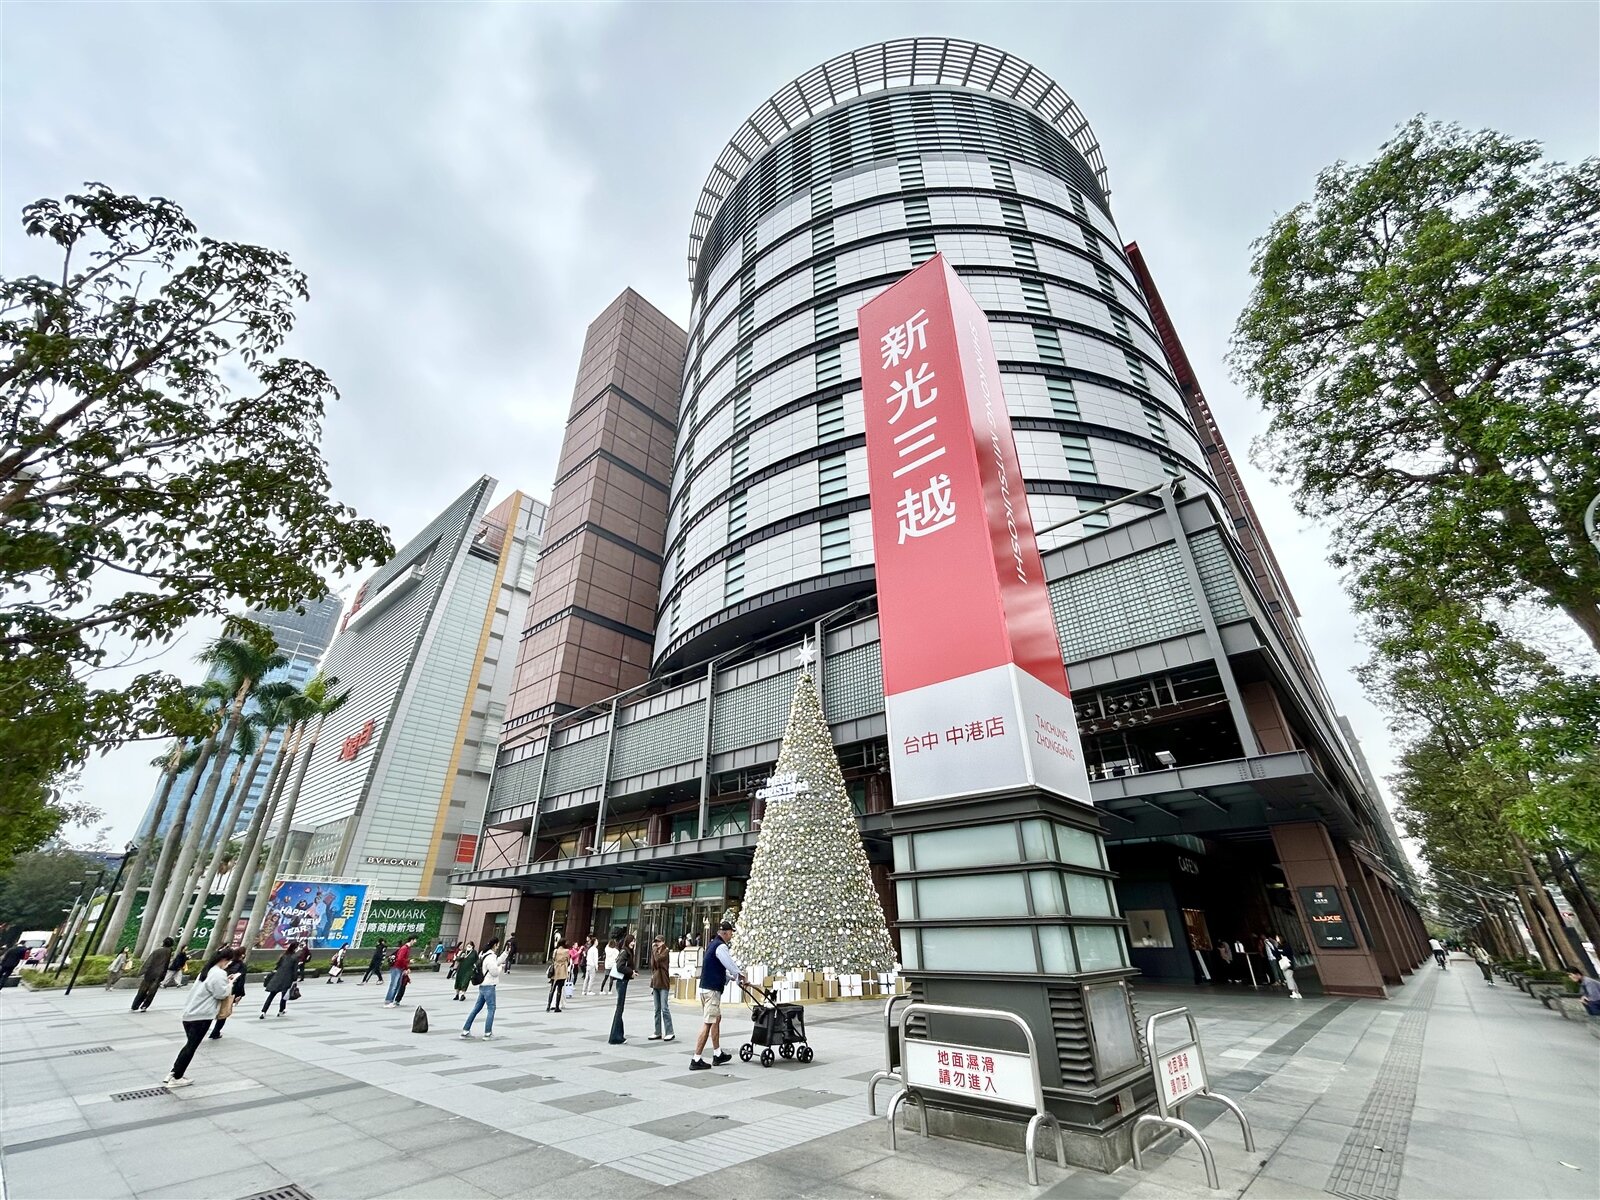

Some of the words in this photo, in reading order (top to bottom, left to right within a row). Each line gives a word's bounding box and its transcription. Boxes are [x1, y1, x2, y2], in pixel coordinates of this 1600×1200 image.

[881, 308, 956, 545] 新光三越
[969, 320, 997, 429] SHINKONG
[990, 430, 1028, 585] MITSUKOSHI
[904, 732, 939, 756] 台中
[946, 716, 1005, 746] 中港店
[1035, 714, 1069, 742] TAICHUNG
[1034, 730, 1076, 761] ZHONGGANG
[756, 780, 809, 799] CHRISTMAS
[766, 771, 798, 787] MERRY
[367, 856, 420, 867] BVLGARI
[280, 906, 311, 918] HAPPY
[299, 918, 321, 926] NEW
[367, 908, 428, 919] ANDMARK
[281, 926, 307, 937] YEAR
[937, 1050, 995, 1073] 地面濕滑
[938, 1068, 997, 1094] 請勿進入
